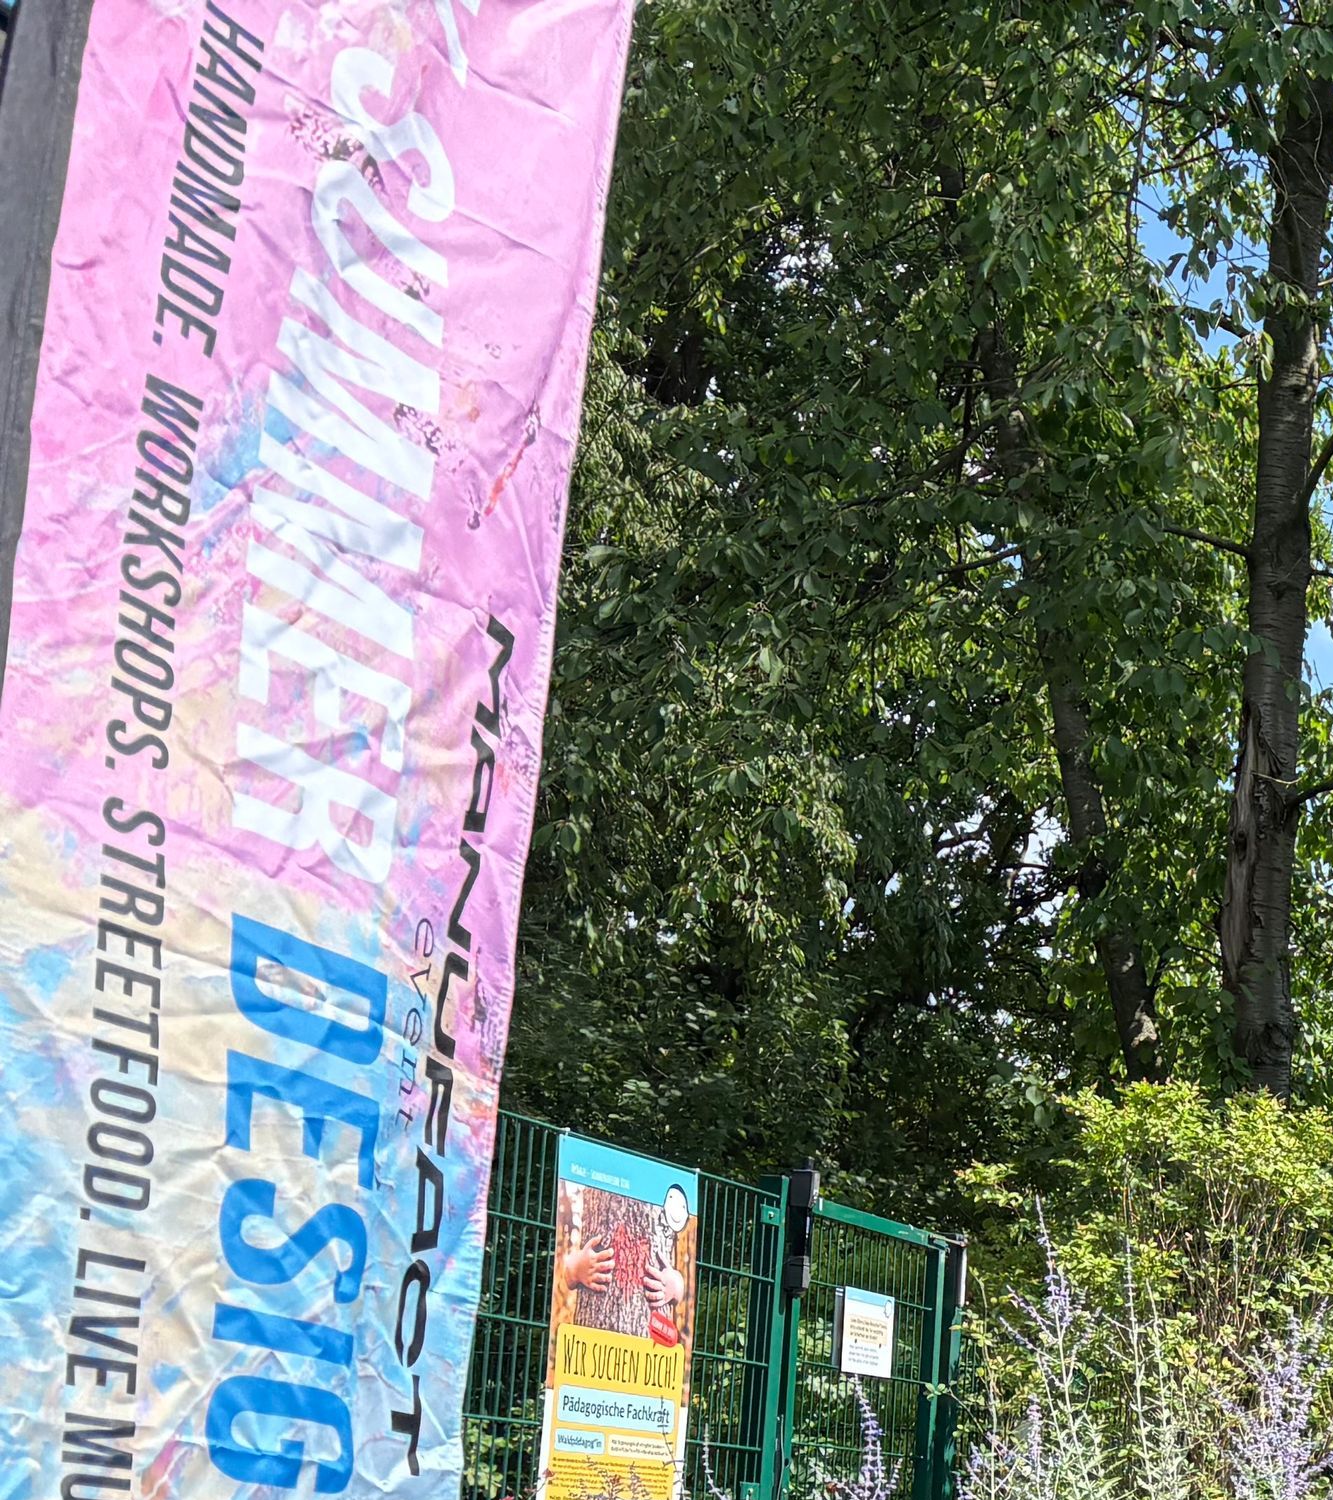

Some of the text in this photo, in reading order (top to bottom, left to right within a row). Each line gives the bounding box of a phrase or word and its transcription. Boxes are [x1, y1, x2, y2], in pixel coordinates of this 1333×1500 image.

[151, 4, 265, 359] HANDMADE.
[103, 372, 204, 771] WORKSHOPS.
[232, 46, 455, 884] SUMMER
[79, 796, 166, 1222] STREETFOOD.
[390, 611, 515, 1477] MANUFACT
[398, 917, 435, 1128] event
[64, 1246, 146, 1396] LIVE
[562, 1395, 625, 1419] Pädagogische
